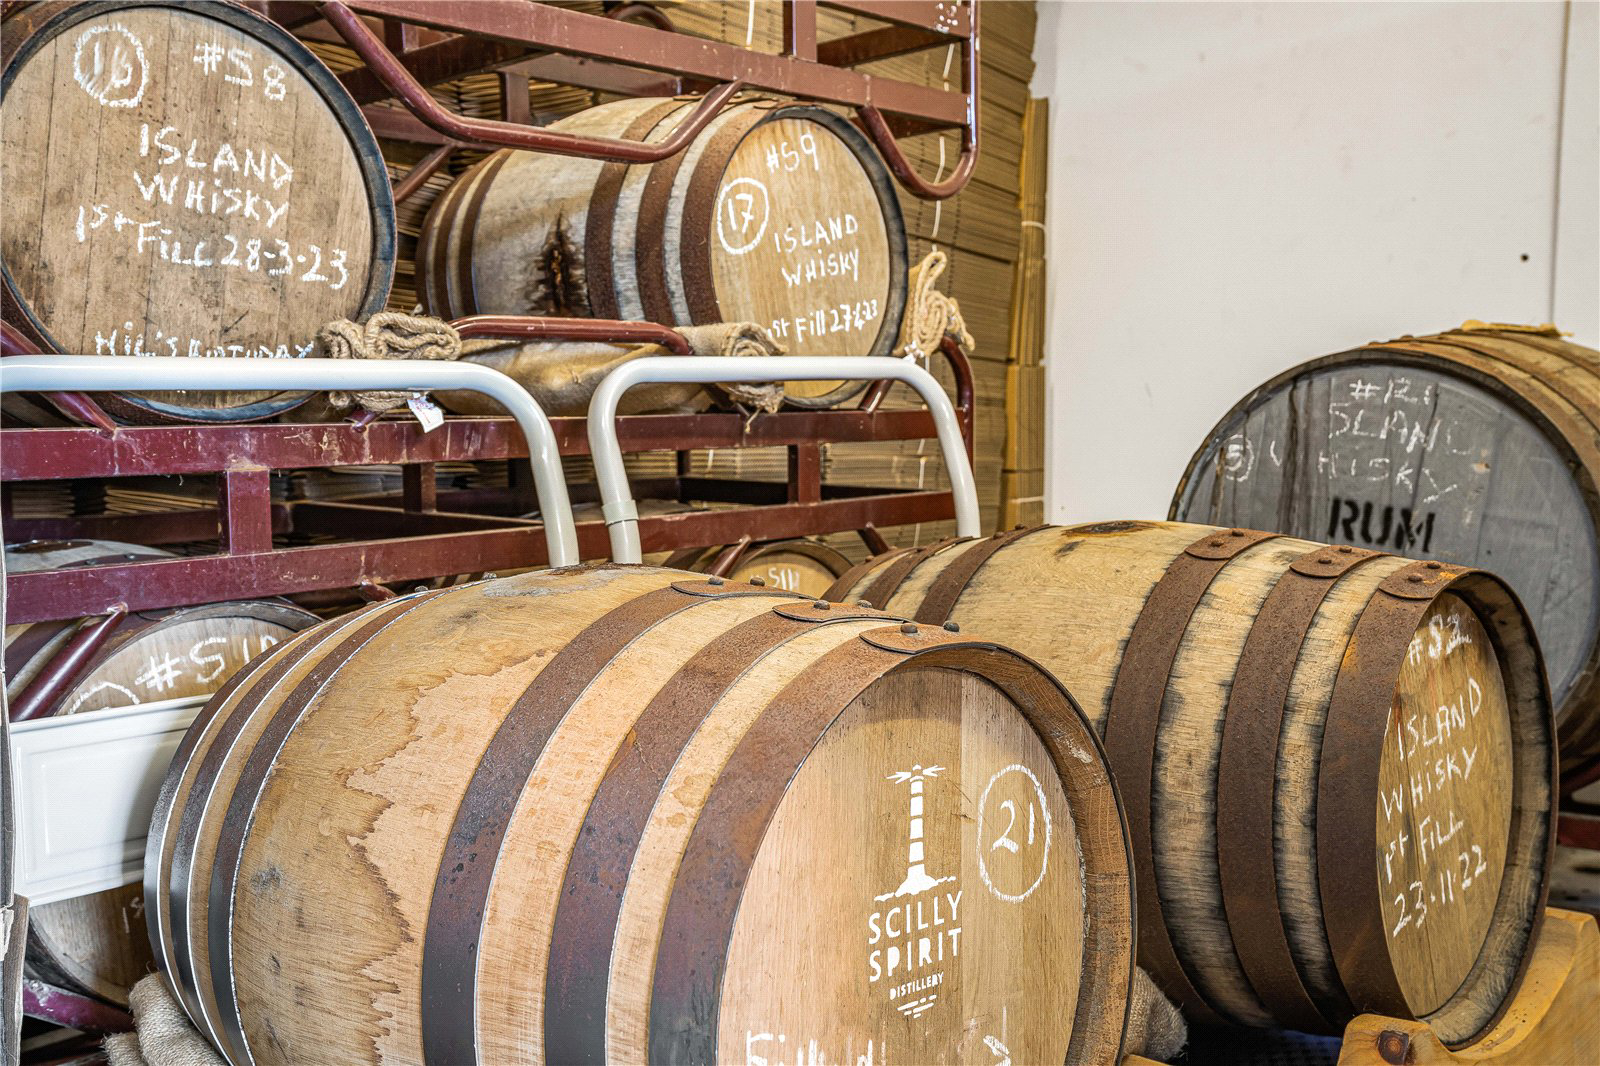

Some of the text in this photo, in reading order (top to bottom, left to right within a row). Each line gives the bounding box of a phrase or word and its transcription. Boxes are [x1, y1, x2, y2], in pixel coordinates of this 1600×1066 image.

[138, 123, 293, 191] ISLAND
[727, 193, 754, 234] 17
[774, 214, 859, 253] ISLAND
[1328, 496, 1437, 553] RUM
[1397, 678, 1482, 763] ISLAND
[868, 890, 963, 945] SCILLY
[868, 927, 963, 982] SPIRIT
[889, 971, 944, 1001] DISTILLERY
